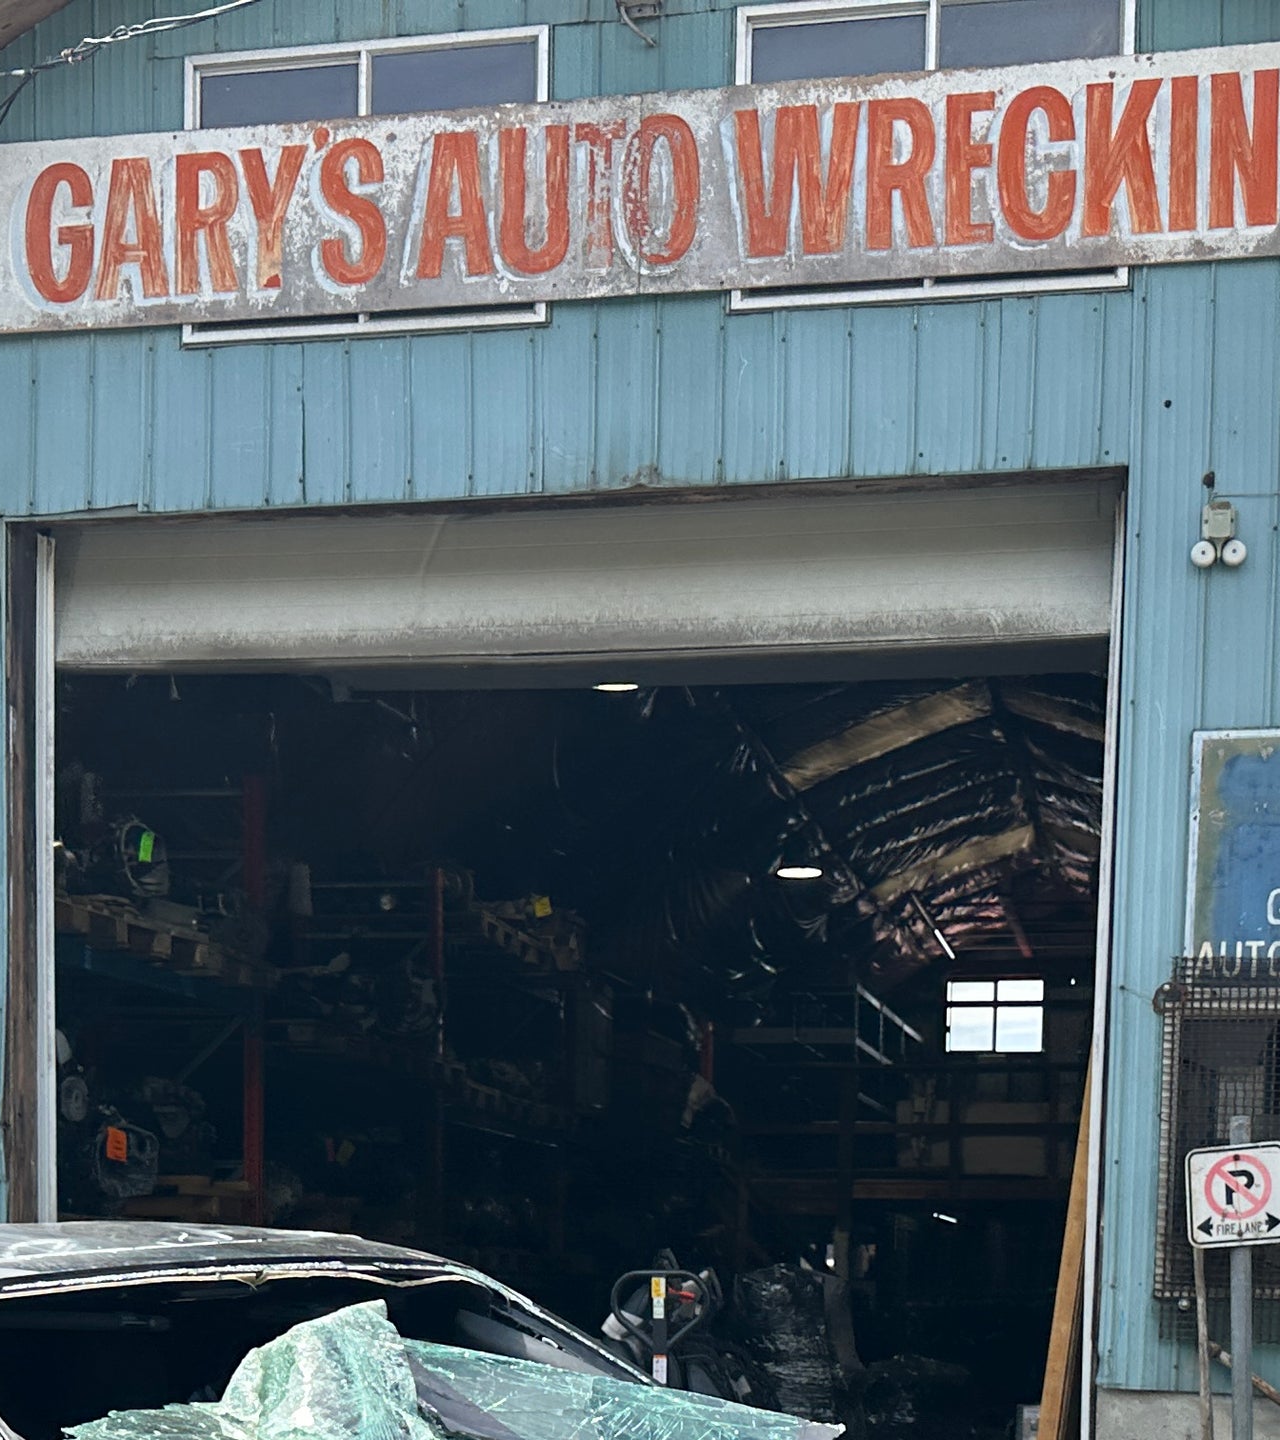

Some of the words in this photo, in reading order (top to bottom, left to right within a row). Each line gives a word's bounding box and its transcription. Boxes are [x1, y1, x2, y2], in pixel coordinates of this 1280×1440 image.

[24, 127, 387, 304] GARY'S
[416, 113, 701, 280] AUTO
[1215, 1222, 1236, 1236] FIRE
